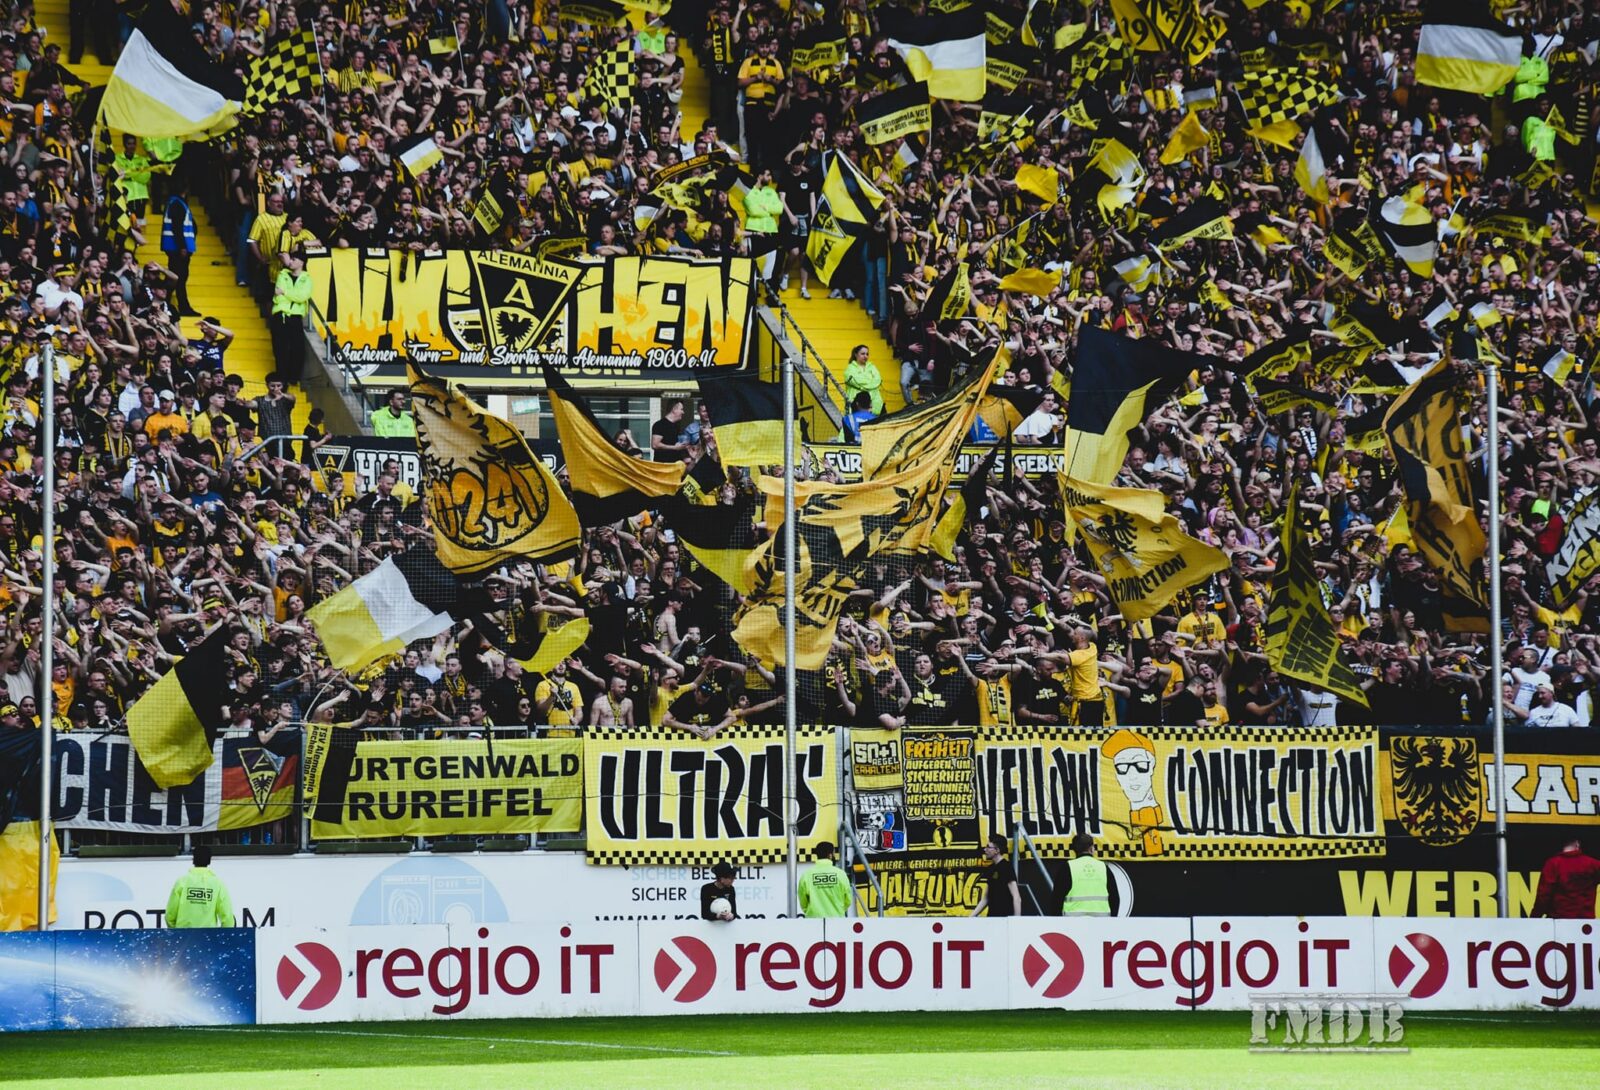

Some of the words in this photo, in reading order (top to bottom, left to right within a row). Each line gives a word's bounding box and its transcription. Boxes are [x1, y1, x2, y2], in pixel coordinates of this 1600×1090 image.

[459, 347, 484, 364] und
[572, 347, 643, 367] Alemannia
[646, 348, 688, 368] 1900
[906, 770, 972, 782] SICHERHEIT
[956, 759, 971, 770] UM
[600, 744, 824, 840] ULTRAS
[907, 782, 921, 793] ZU
[940, 793, 972, 804] BEIDES
[976, 746, 1100, 839] YELLOW
[1167, 744, 1375, 838] CONNECTION
[348, 787, 553, 821] RUREIFEL
[859, 794, 897, 812] NEIN
[908, 806, 921, 817] ZU
[923, 805, 973, 817] VERLIEREN
[631, 866, 687, 880] SICHER
[691, 866, 766, 880] BESLLT.
[885, 860, 907, 870] LEBE
[939, 858, 965, 868] IMER
[631, 887, 687, 901] SICHER
[868, 871, 988, 910] HALTUNG
[1338, 870, 1543, 918] WERN
[356, 926, 540, 1015] regio
[735, 922, 913, 1007] regio
[1102, 921, 1279, 1007] regio
[1467, 923, 1600, 1008] regi
